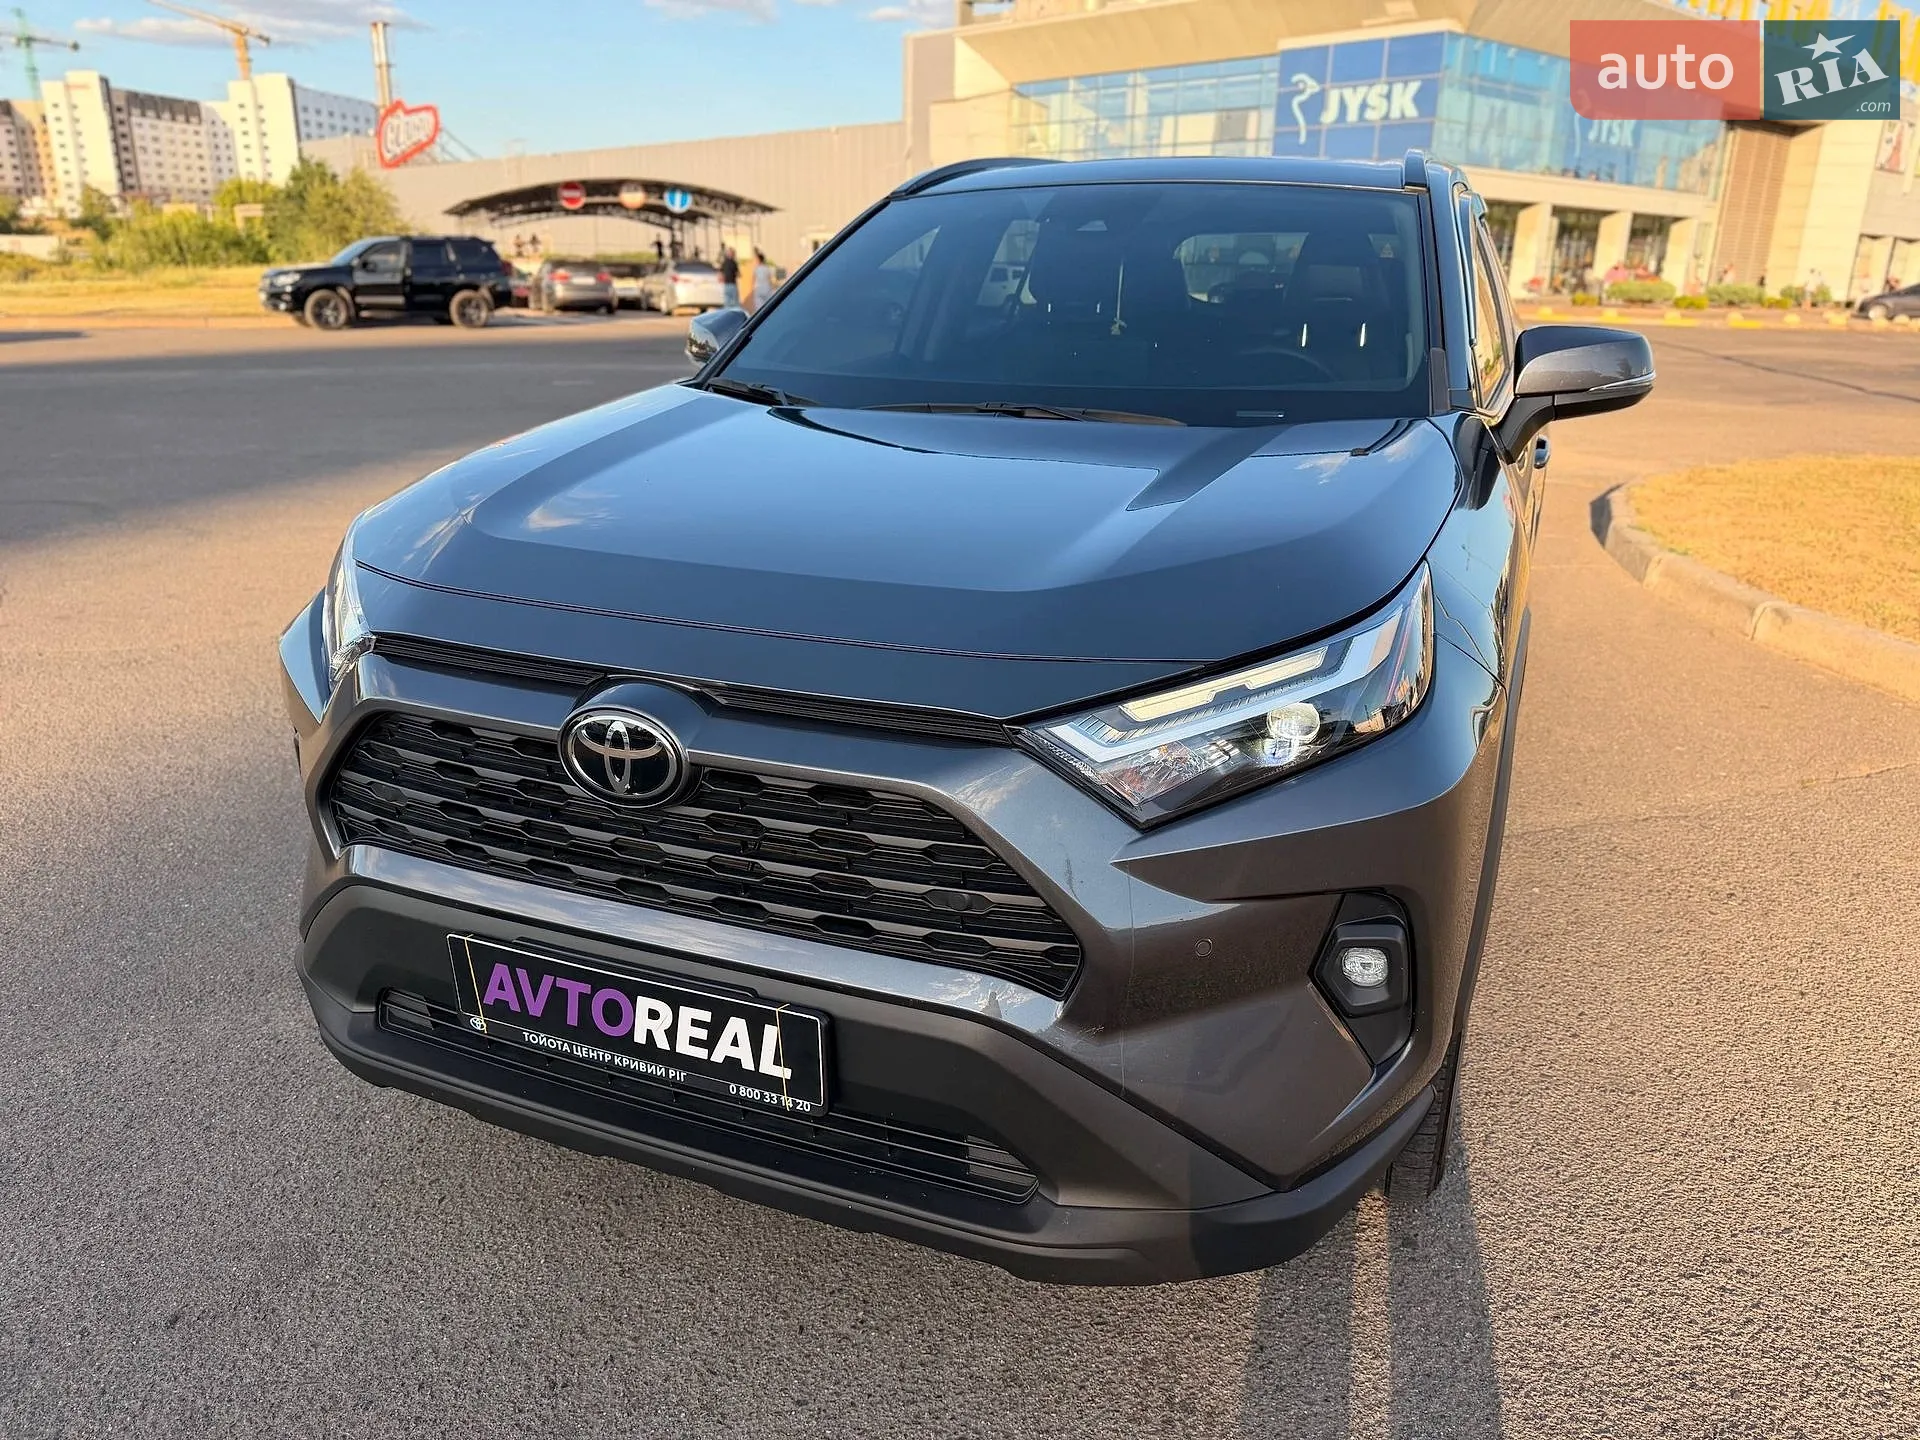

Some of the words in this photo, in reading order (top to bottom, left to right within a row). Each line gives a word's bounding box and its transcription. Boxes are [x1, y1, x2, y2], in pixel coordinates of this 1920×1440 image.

[1320, 80, 1422, 124] JYSK
[483, 962, 793, 1080] AVTOREAL
[522, 1031, 571, 1053] ТОЙОТА
[572, 1044, 612, 1063] ЦЕНТР
[614, 1056, 667, 1078] КРИВИЙ
[668, 1069, 687, 1082] РІГ
[729, 1084, 737, 1095] 0
[739, 1086, 761, 1100] 800
[763, 1092, 778, 1104] 33
[796, 1100, 811, 1112] 20
